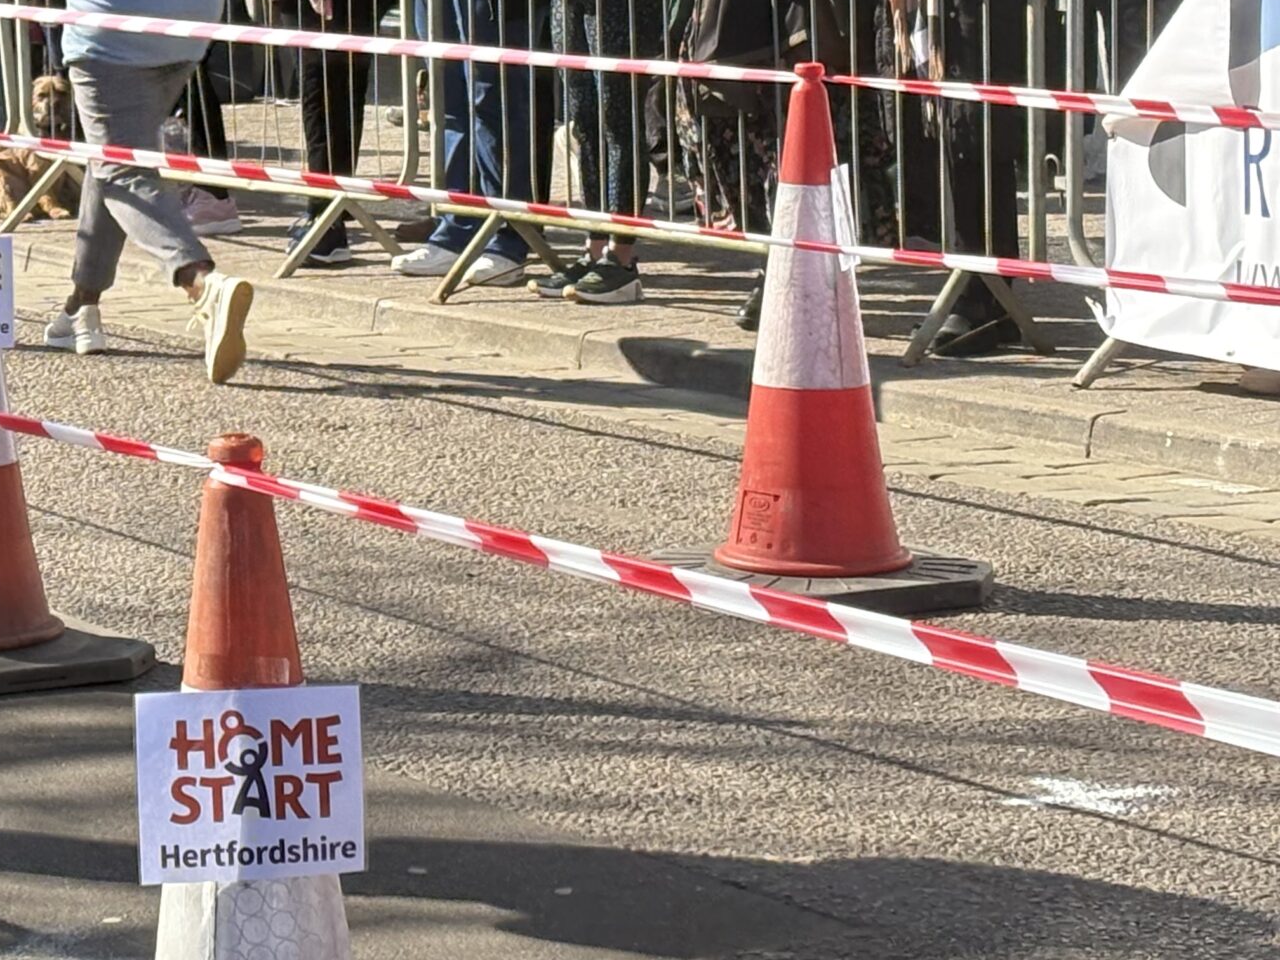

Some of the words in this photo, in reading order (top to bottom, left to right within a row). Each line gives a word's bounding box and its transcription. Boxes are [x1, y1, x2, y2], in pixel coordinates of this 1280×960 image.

[169, 710, 343, 771] HOME
[170, 770, 343, 825] START
[160, 835, 357, 869] Hertfordshire
